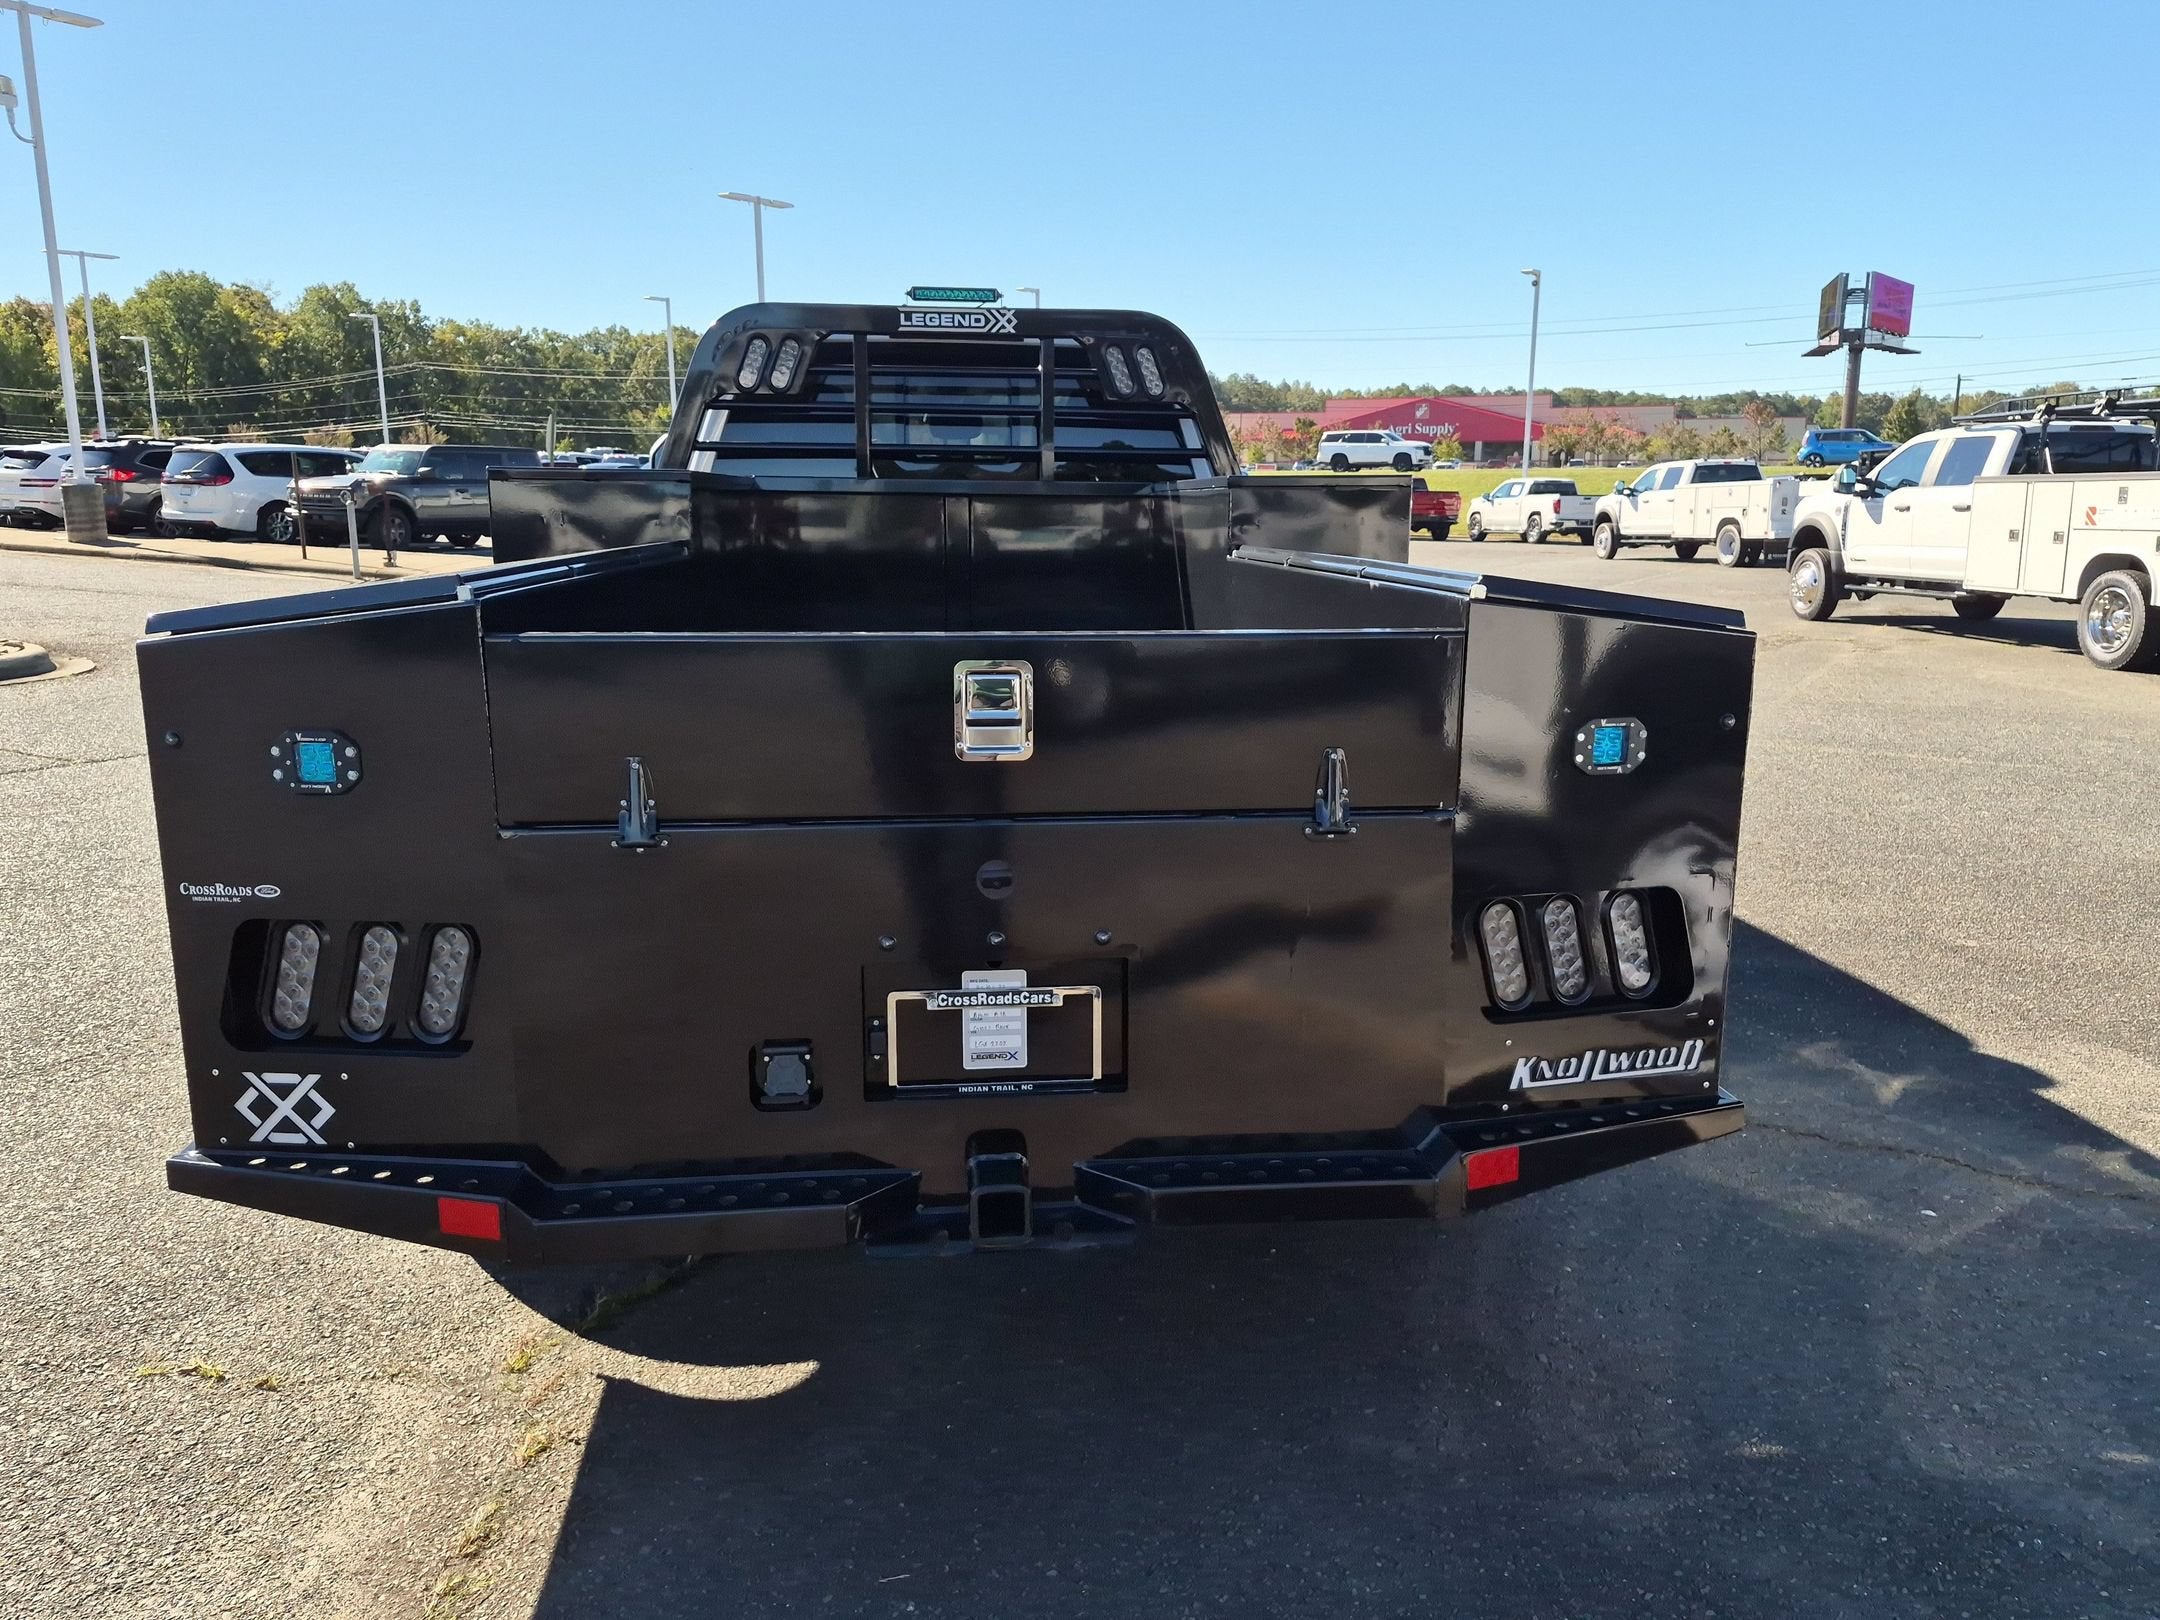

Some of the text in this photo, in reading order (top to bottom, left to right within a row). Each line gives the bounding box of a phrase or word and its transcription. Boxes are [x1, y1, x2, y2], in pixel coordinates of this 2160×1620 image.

[1388, 422, 1455, 437] Agri Supply
[937, 991, 1052, 1007] CrossRoadsCars
[958, 1085, 989, 1093] INDIAN
[990, 1084, 1019, 1092] TRAIL,
